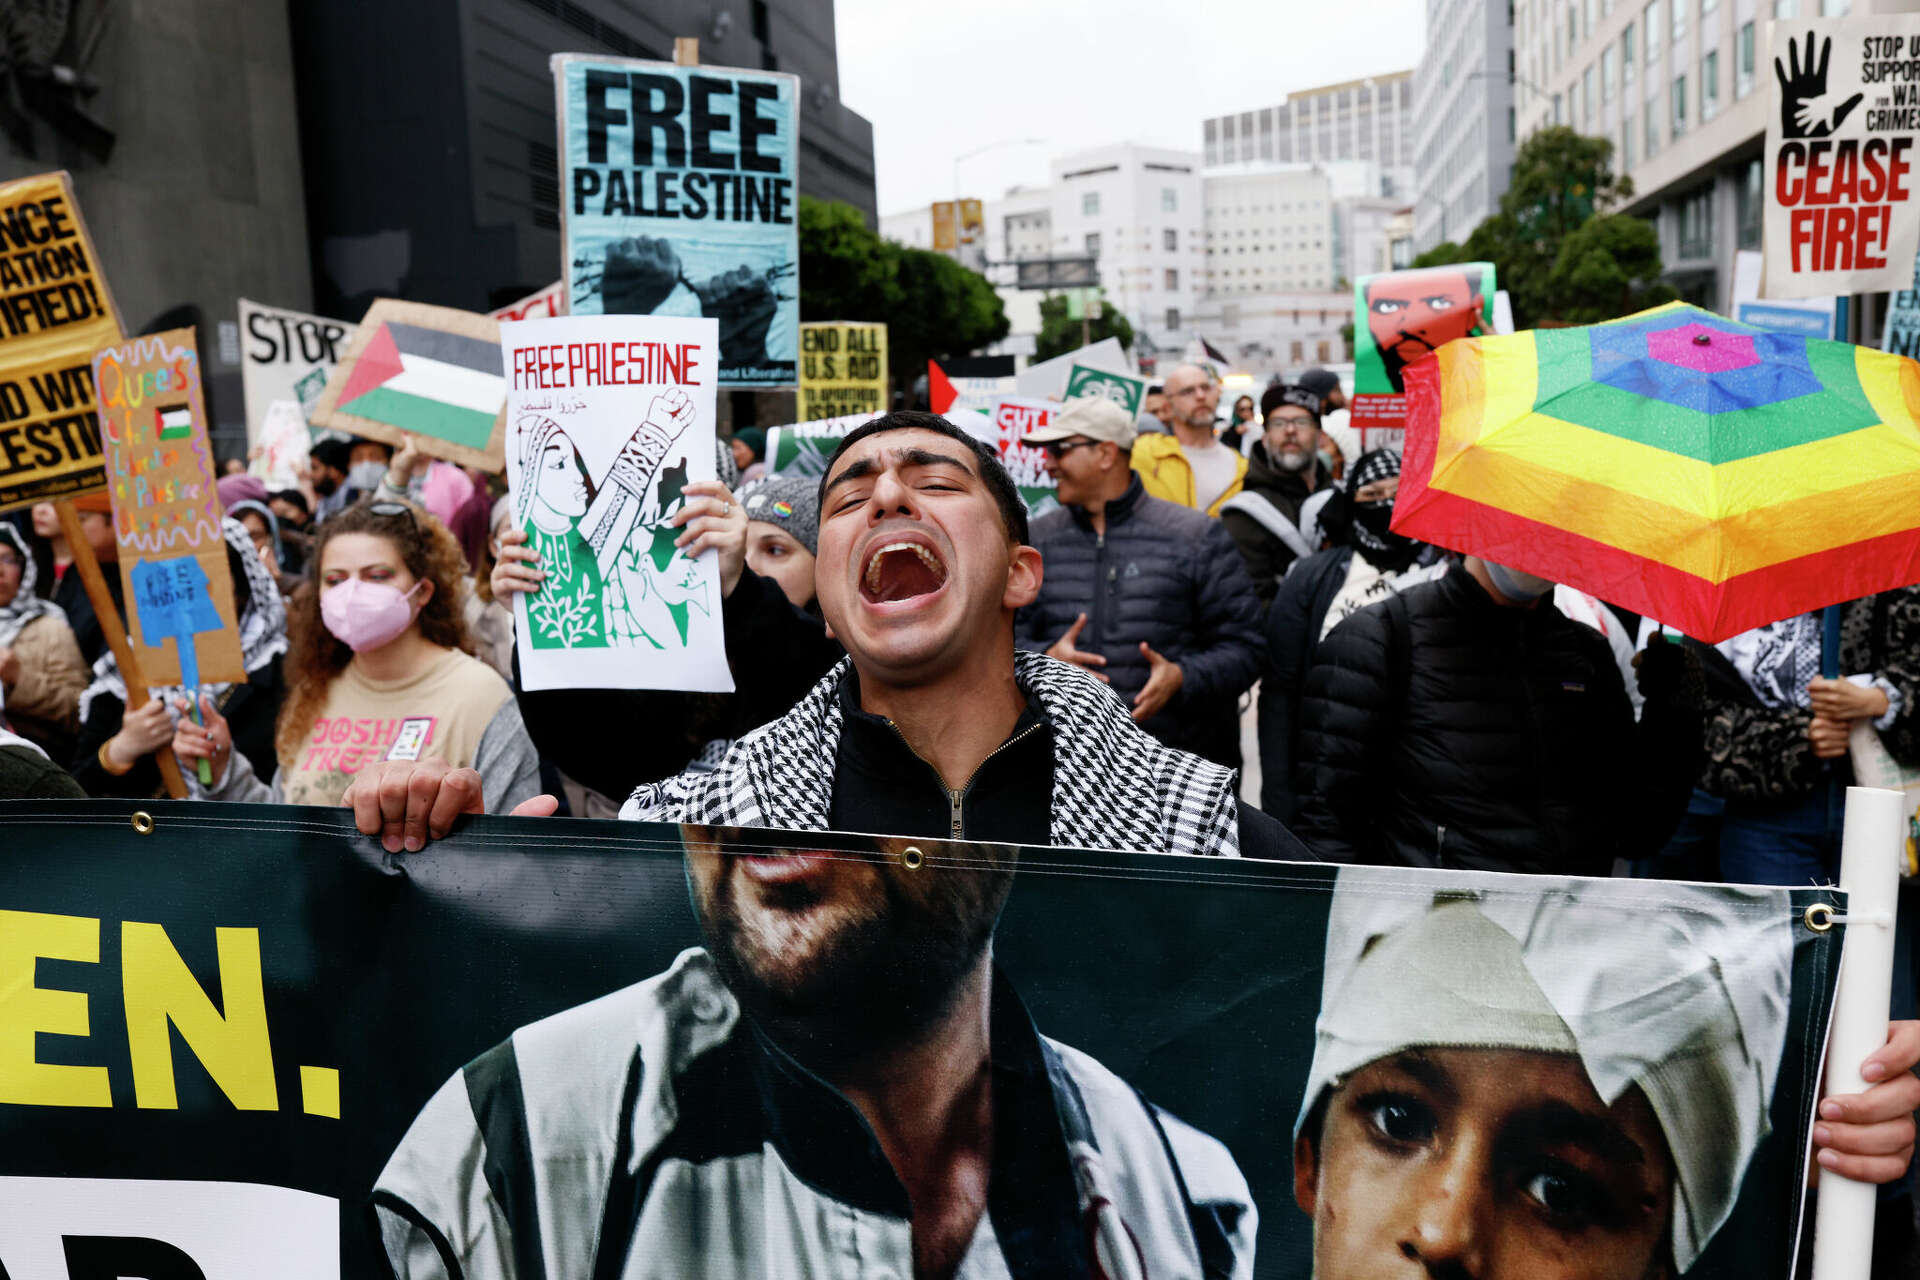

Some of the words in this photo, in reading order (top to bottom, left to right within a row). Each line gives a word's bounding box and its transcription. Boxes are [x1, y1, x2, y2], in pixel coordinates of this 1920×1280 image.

[1863, 36, 1904, 59] STOP
[1910, 35, 1920, 58] U
[585, 68, 782, 174] FREE
[1893, 84, 1920, 106] WA
[573, 167, 794, 225] PALESTINE
[1776, 137, 1913, 207] CEASE
[1790, 205, 1892, 273] FIRE!
[0, 279, 105, 339] IFIED!
[249, 313, 345, 366] STOP
[803, 328, 839, 352] END
[847, 328, 880, 352] ALL
[28, 363, 96, 413] WIT
[99, 356, 187, 409] Queers
[848, 356, 879, 380] AID
[0, 411, 103, 478] ESTI
[312, 716, 439, 746] JOSH
